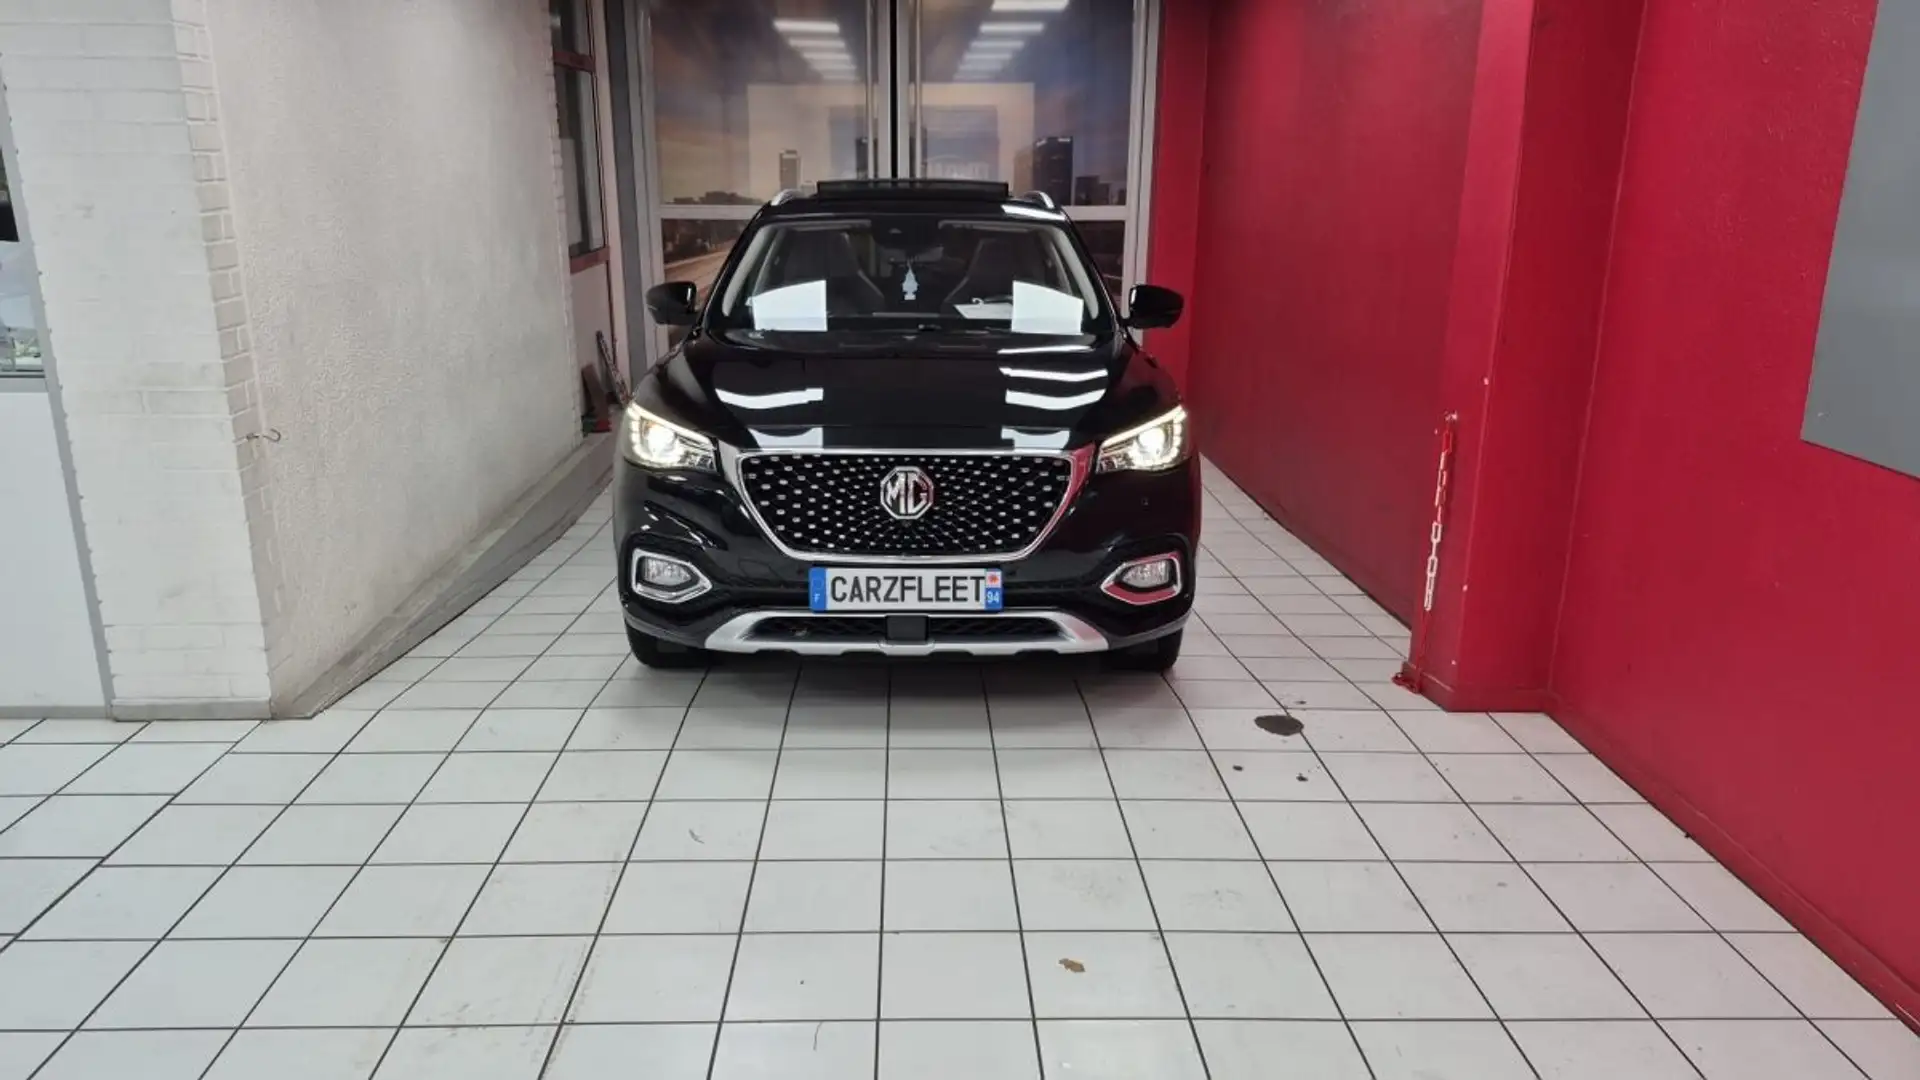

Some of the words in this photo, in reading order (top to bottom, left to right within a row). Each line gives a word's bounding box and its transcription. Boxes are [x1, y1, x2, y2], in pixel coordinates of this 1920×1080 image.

[886, 472, 928, 514] MG
[831, 576, 985, 602] CARZFLEET
[987, 590, 1000, 604] 94
